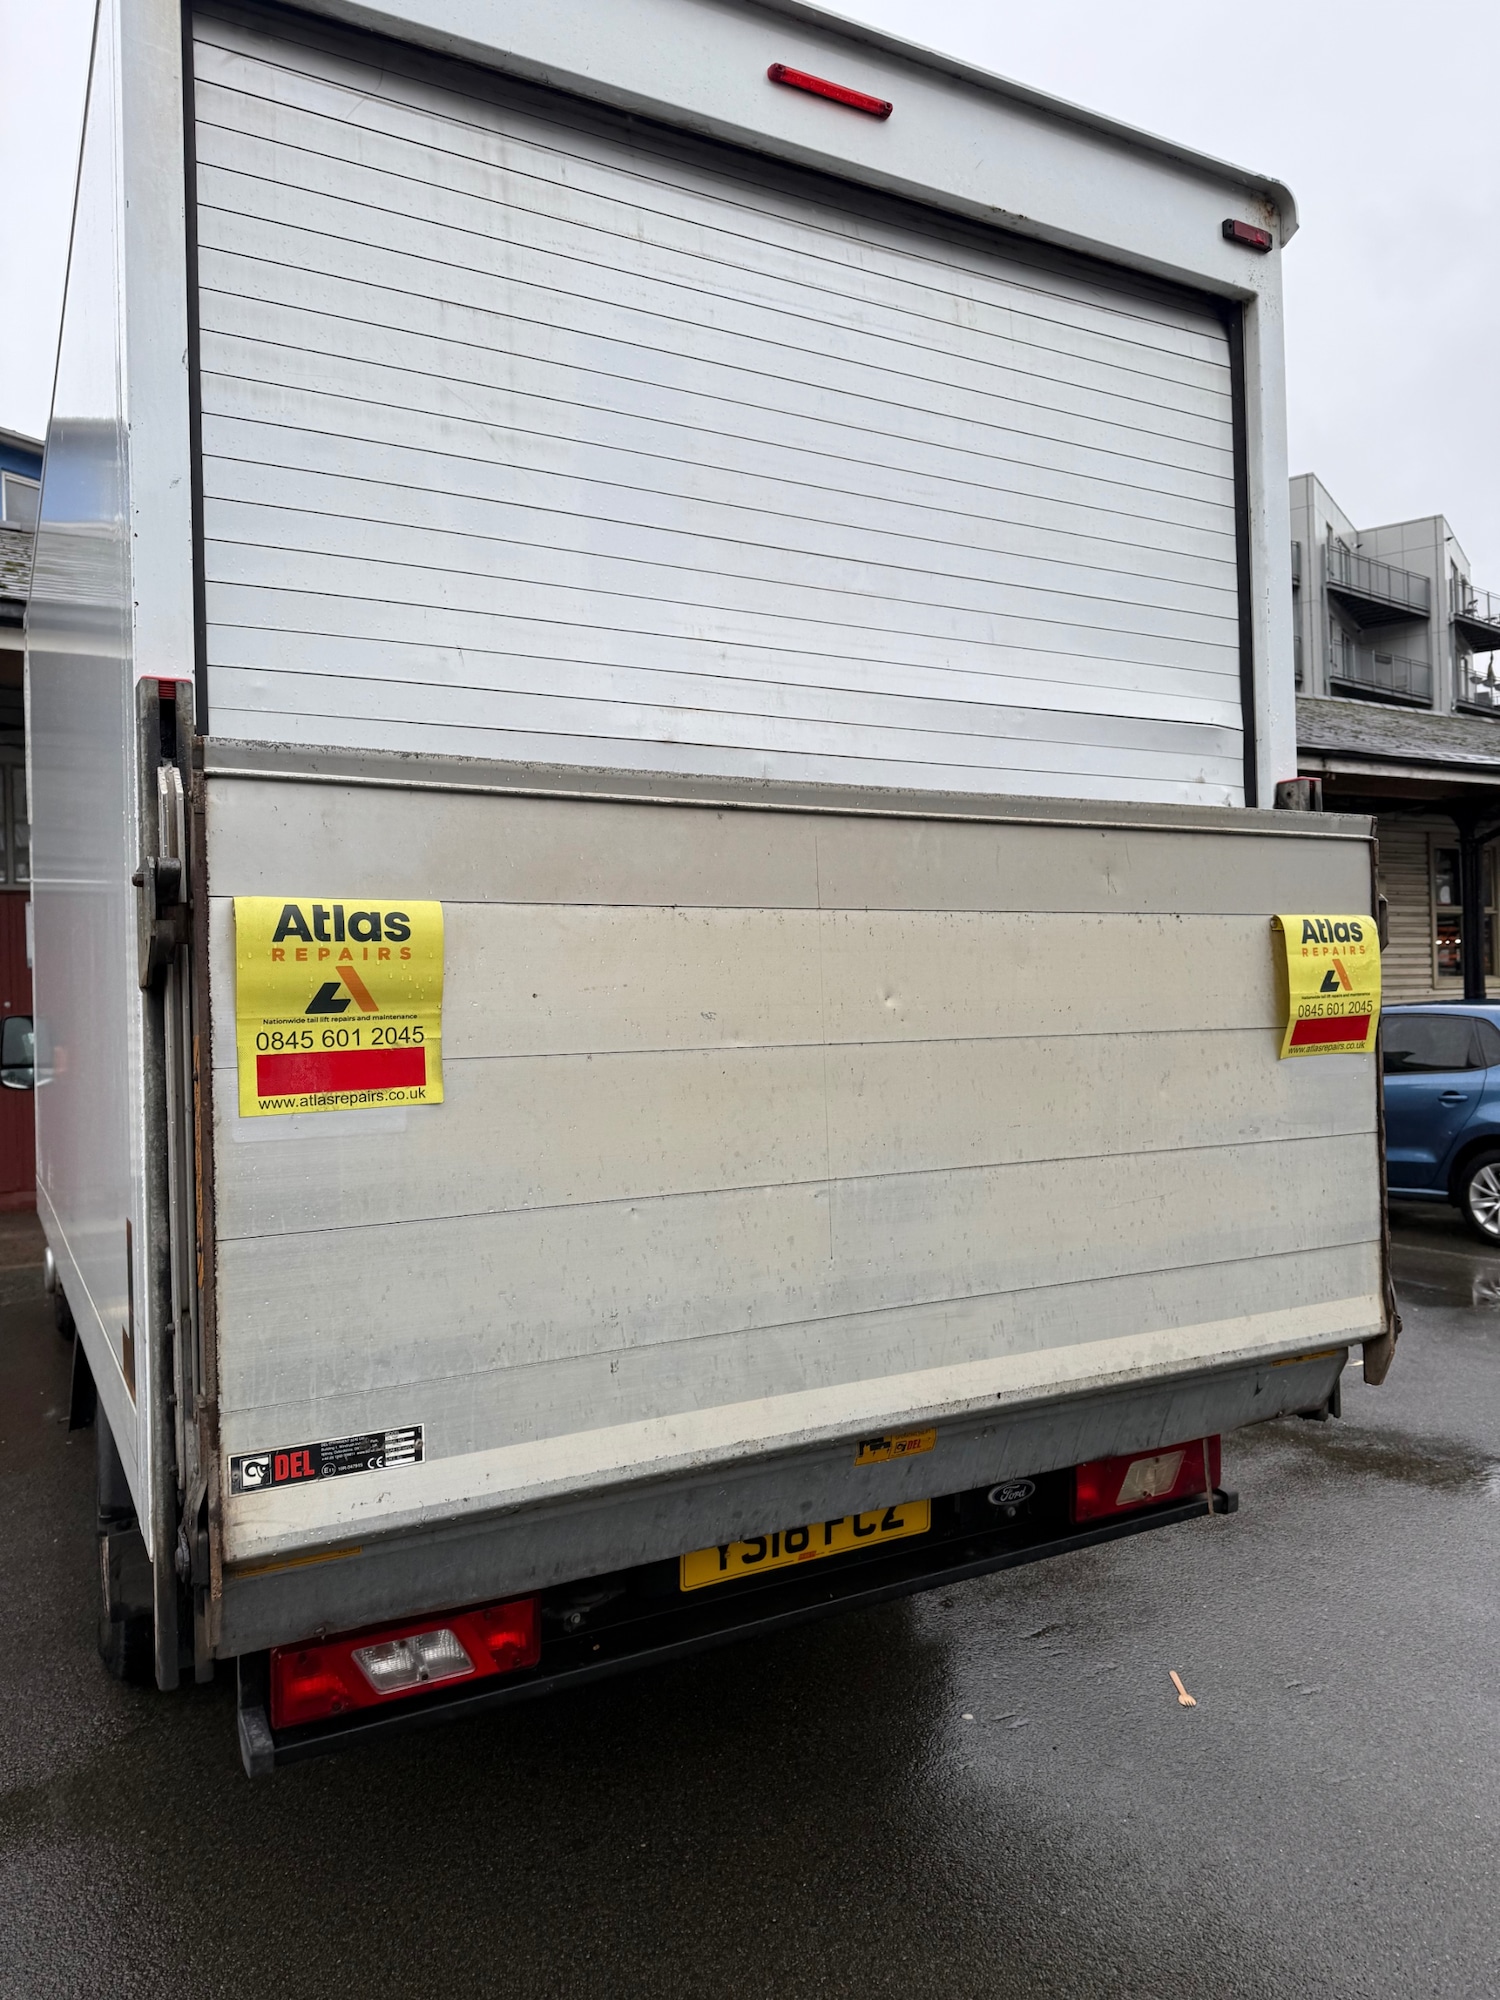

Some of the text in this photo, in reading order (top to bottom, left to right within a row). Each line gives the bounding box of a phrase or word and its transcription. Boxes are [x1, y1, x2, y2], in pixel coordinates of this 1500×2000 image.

[272, 904, 411, 943] Atlas
[1301, 918, 1363, 944] Atlas
[272, 947, 412, 961] REPAIRS
[1301, 945, 1366, 957] REPAIRS
[1298, 1000, 1373, 1018] 0845 601 2045
[263, 1017, 306, 1025] Nationwide
[307, 1016, 319, 1024] tail
[331, 1015, 356, 1024] repairs
[372, 1013, 418, 1021] maintenance
[256, 1026, 425, 1051] 0845 601 2045
[1288, 1041, 1366, 1054] www.atlasrepairs.co.uk
[258, 1087, 426, 1110] www.atlasrepairs.co.uk
[907, 1438, 921, 1450] DEL
[275, 1450, 315, 1481] DEL
[1000, 1484, 1027, 1502] Ford
